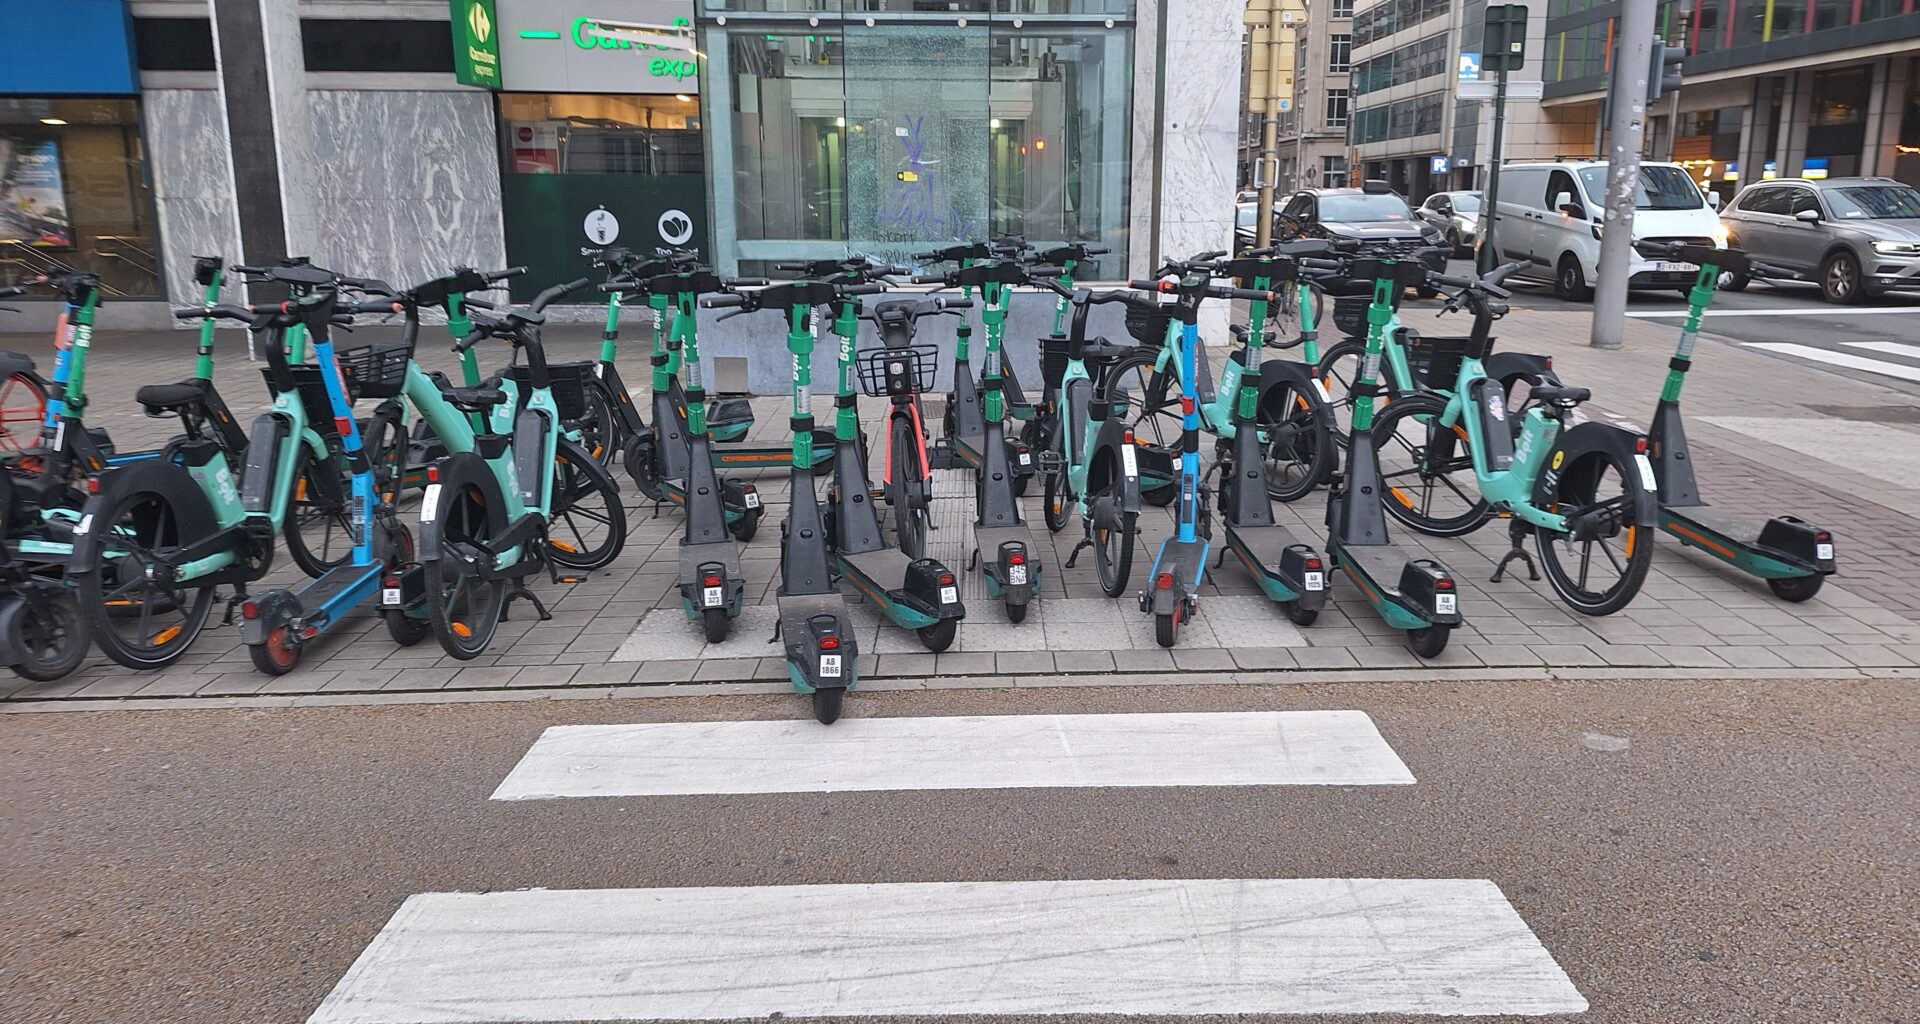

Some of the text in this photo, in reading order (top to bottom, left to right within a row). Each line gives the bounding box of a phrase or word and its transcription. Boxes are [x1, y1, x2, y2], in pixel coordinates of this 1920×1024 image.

[74, 323, 93, 349] Bolt
[839, 335, 853, 362] Bolt
[1220, 369, 1236, 397] Bolt
[1516, 429, 1535, 465] Bolt
[821, 666, 840, 675] 1866
[825, 657, 836, 666] AB
